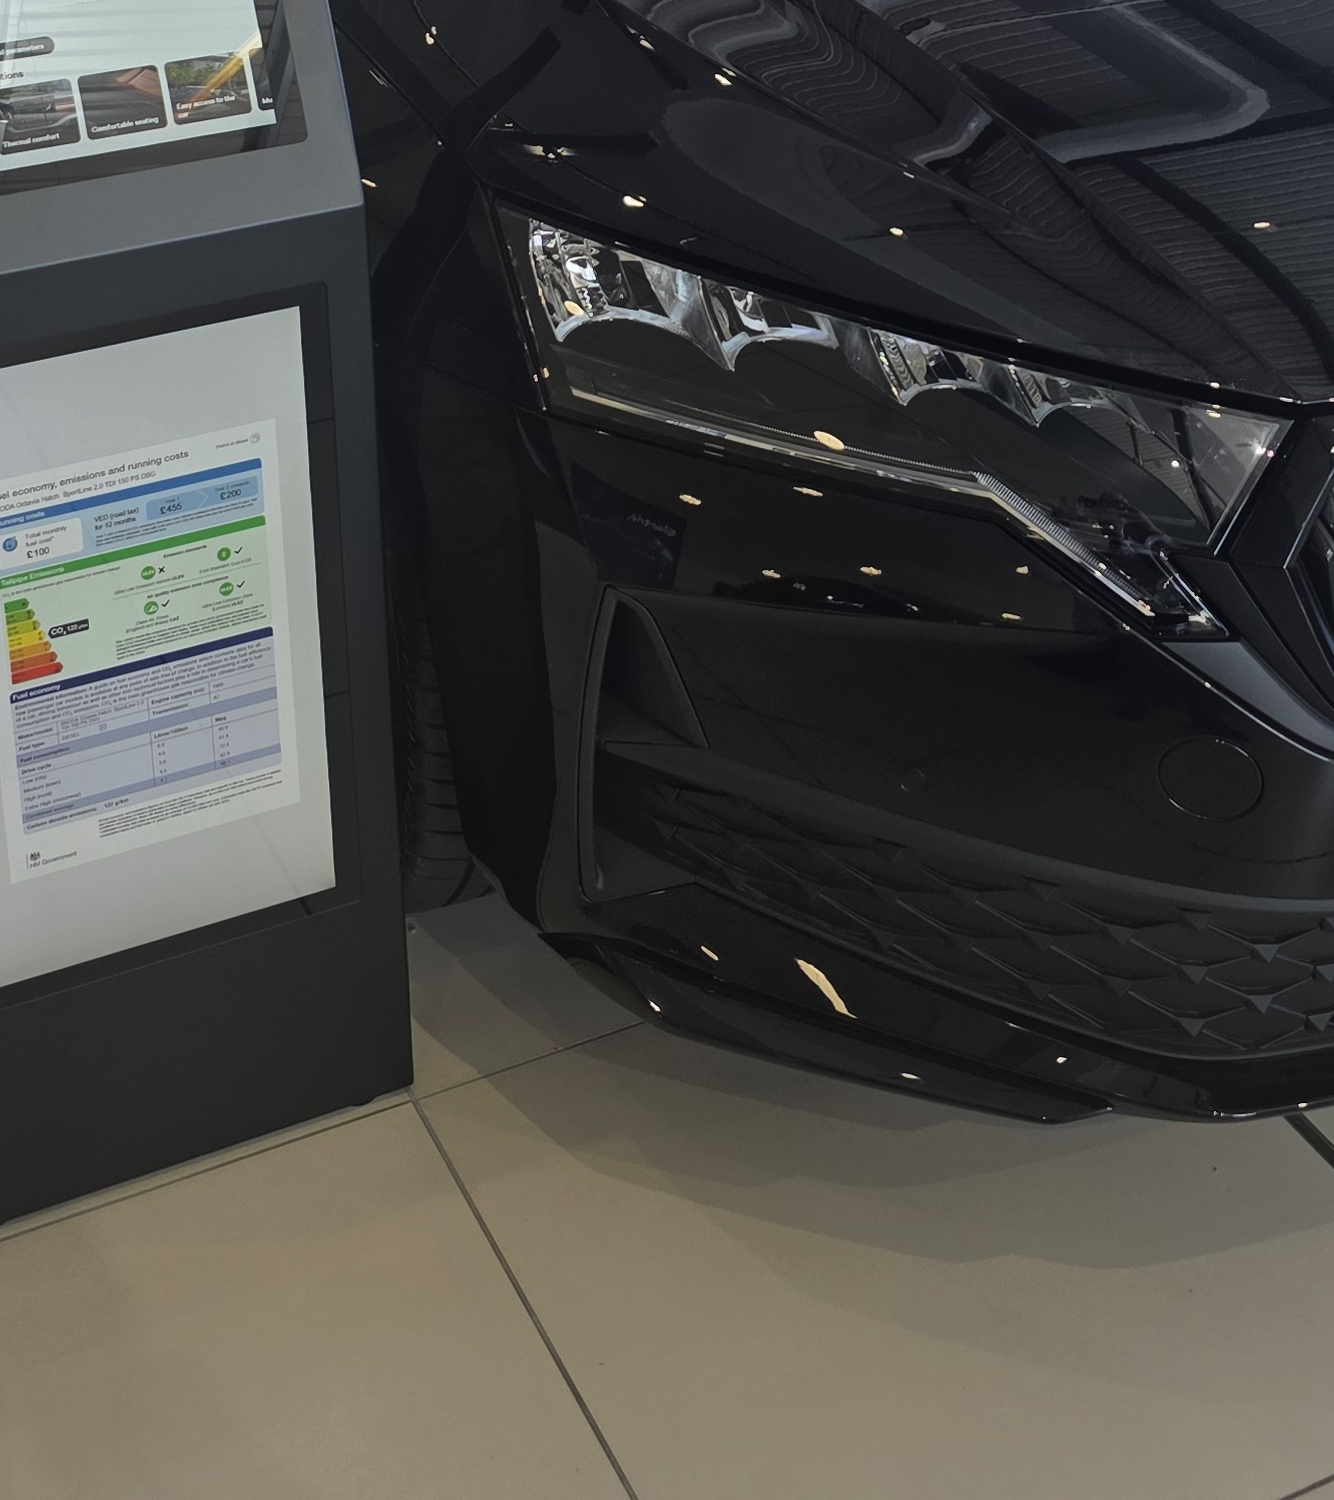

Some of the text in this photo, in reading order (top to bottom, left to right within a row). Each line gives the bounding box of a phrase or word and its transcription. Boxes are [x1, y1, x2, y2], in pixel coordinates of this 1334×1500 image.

[12, 481, 57, 497] economy,
[59, 469, 105, 485] emissions
[107, 464, 125, 475] and
[128, 456, 161, 470] running
[164, 450, 188, 461] costs
[62, 485, 92, 497] SportLine
[93, 482, 103, 490] 2.0
[118, 476, 128, 484] 150
[130, 474, 139, 482] PS
[141, 471, 155, 479] DSG
[220, 488, 241, 500] £200
[159, 502, 182, 514] £455
[25, 511, 45, 519] costs
[94, 514, 108, 522] VED
[110, 510, 125, 519] (road
[114, 516, 135, 525] months
[25, 525, 67, 539] Total monthly
[26, 546, 49, 558] £100
[1, 566, 64, 586] Tailpipe Emissions
[12, 684, 60, 700] Fuel economy
[42, 851, 76, 863] Government
